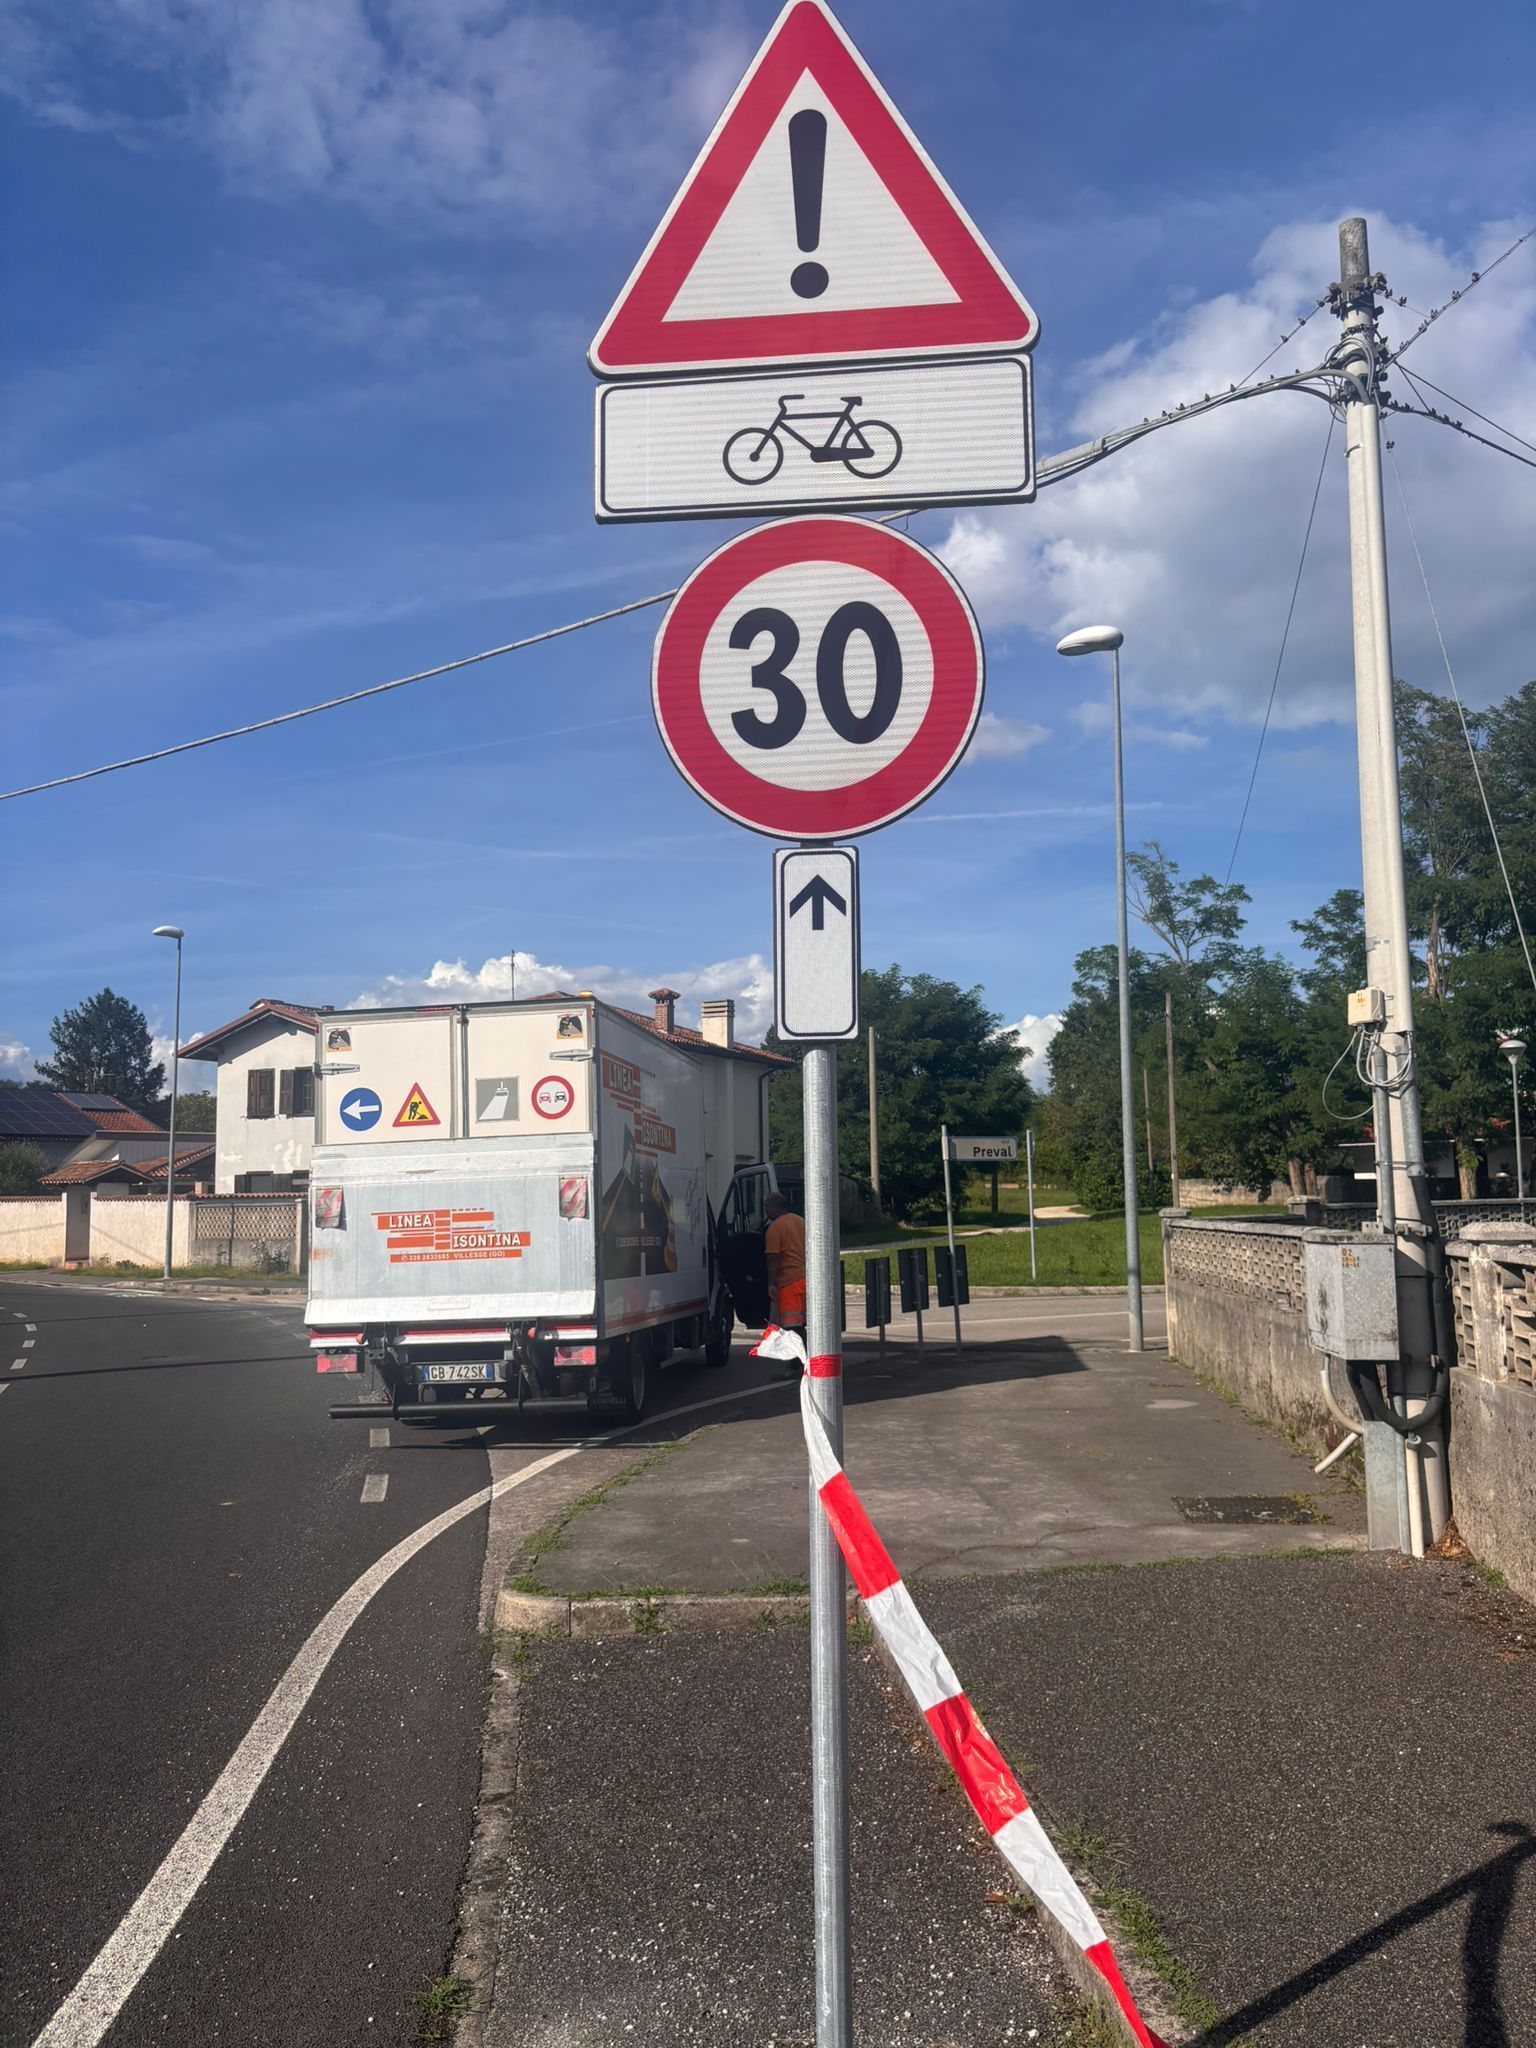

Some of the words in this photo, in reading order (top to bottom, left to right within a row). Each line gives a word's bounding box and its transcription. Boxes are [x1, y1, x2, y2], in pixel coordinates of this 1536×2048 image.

[728, 600, 904, 750] 30
[608, 1061, 632, 1093] LINEA
[643, 1120, 672, 1149] ISONTINA
[973, 1145, 1012, 1157] Preval
[389, 1214, 432, 1228] LINEA
[453, 1233, 521, 1248] ISONTINA
[453, 1251, 488, 1259] VILLESSE
[489, 1249, 506, 1258] (GO)
[430, 1366, 445, 1379] GB
[449, 1365, 486, 1379] 742SK
